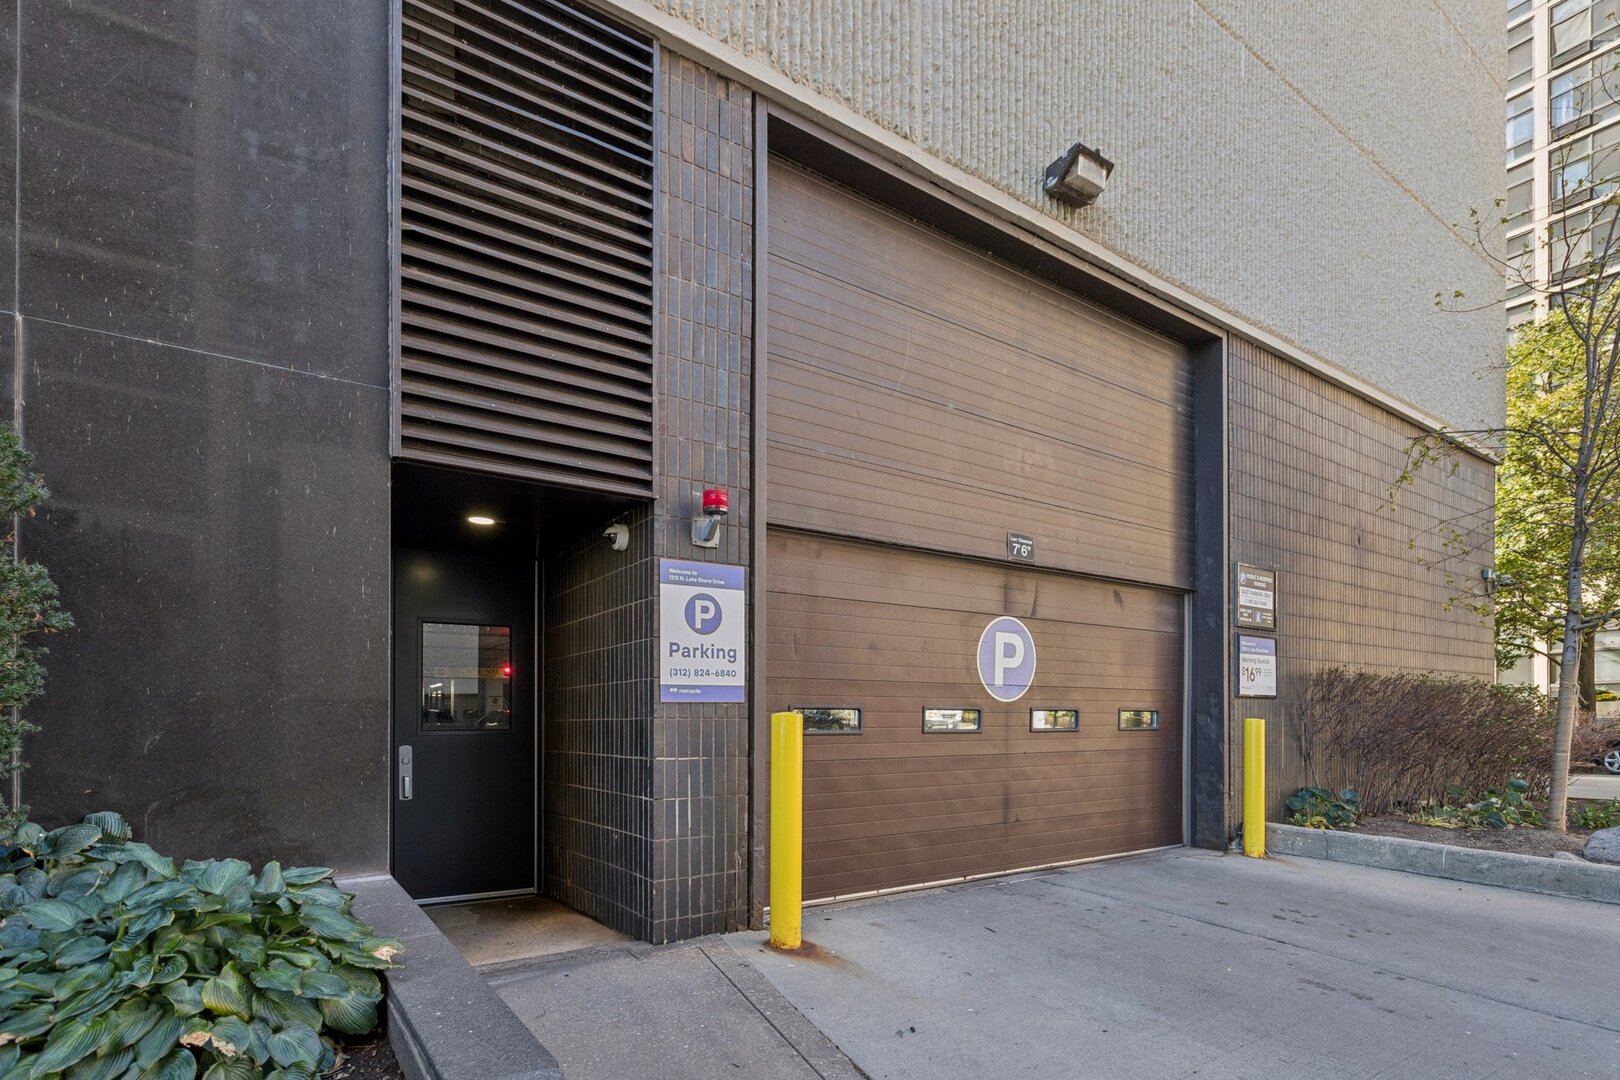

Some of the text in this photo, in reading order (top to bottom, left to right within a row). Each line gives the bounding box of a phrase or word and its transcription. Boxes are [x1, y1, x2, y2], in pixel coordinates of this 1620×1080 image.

[694, 599, 716, 629] P
[668, 641, 737, 664] Parking
[994, 631, 1025, 688] P
[669, 667, 737, 678] (312) 824-6840
[678, 687, 702, 695] metropolis
